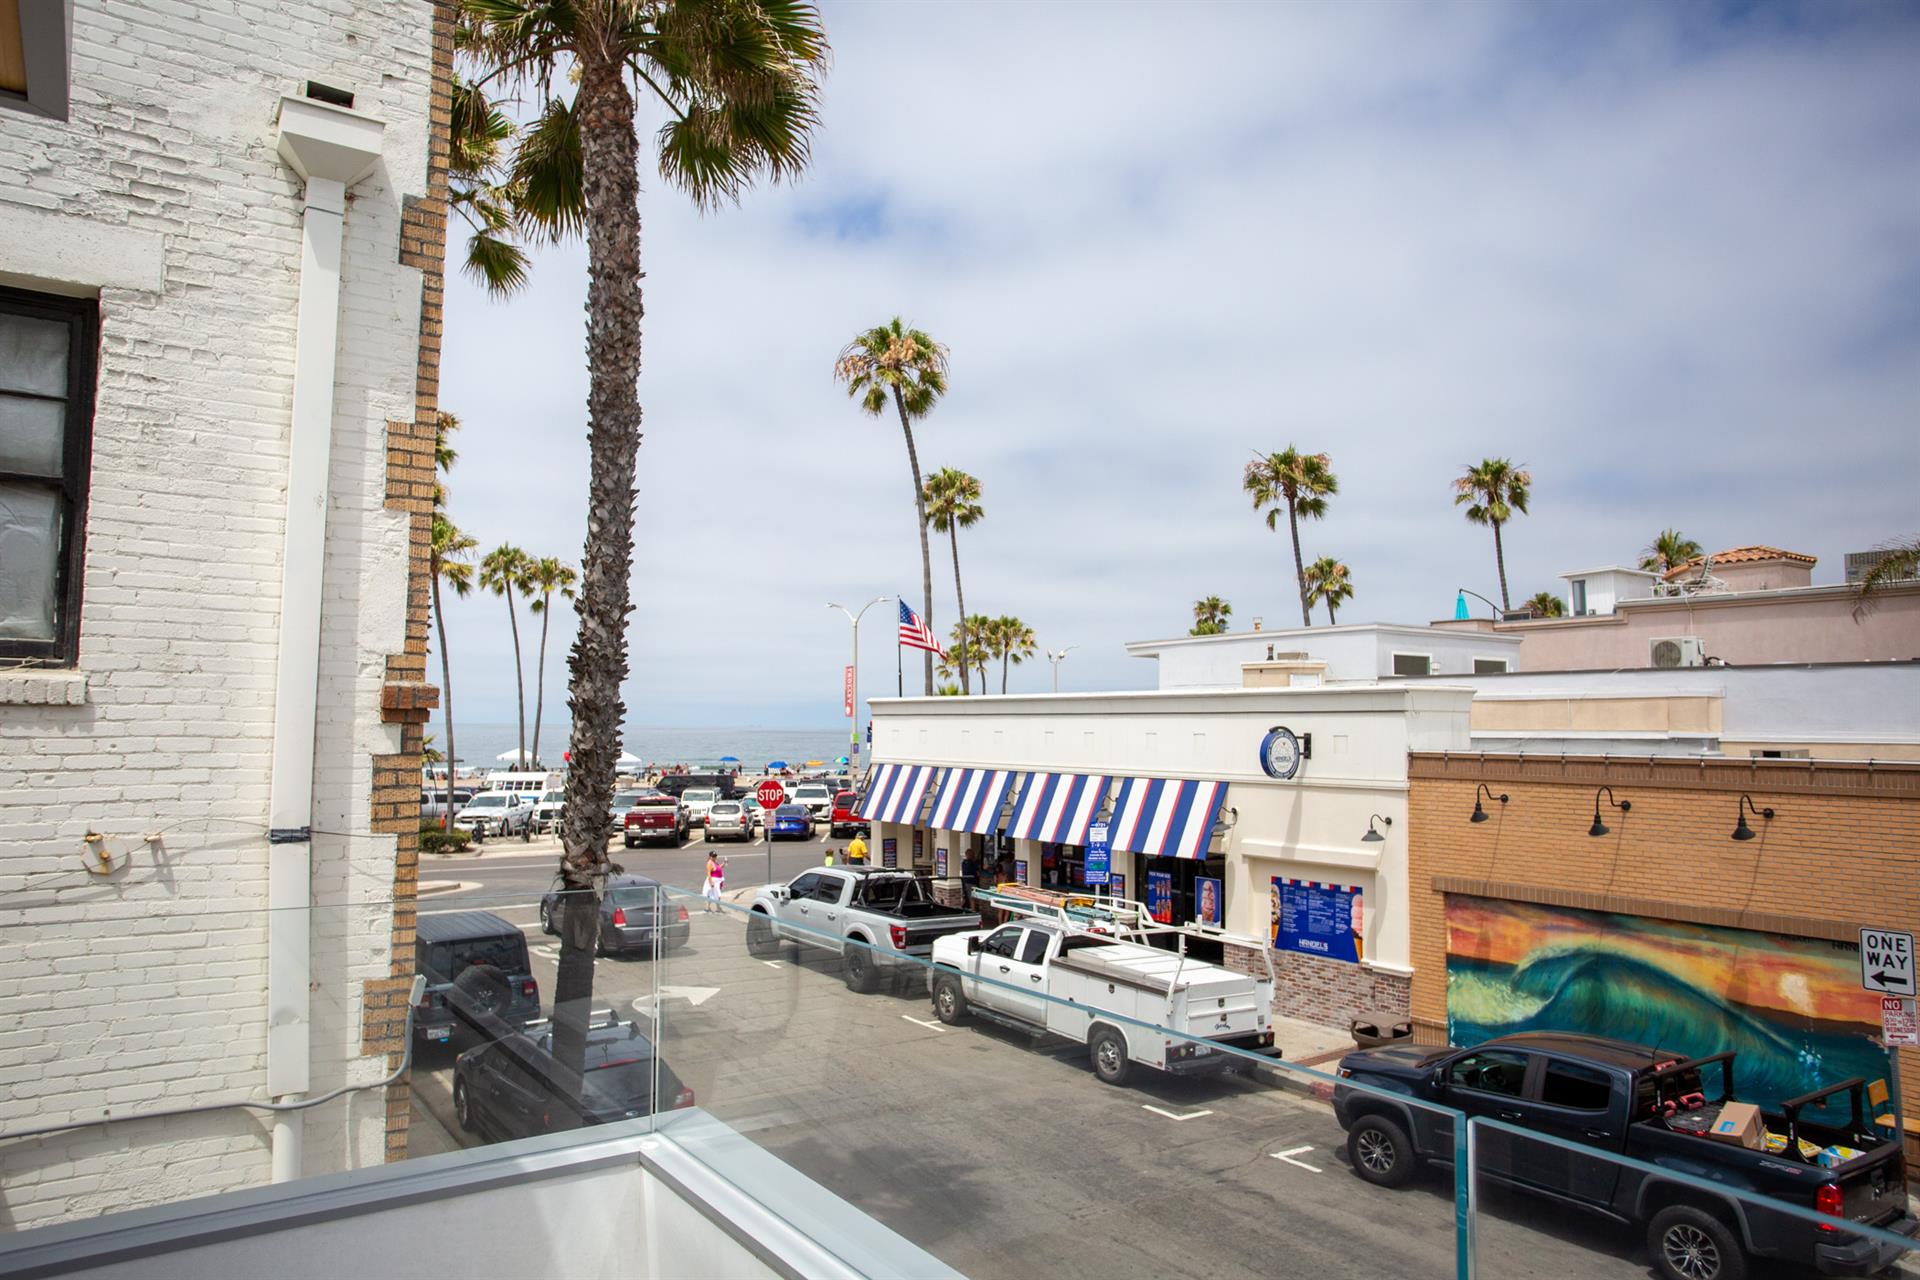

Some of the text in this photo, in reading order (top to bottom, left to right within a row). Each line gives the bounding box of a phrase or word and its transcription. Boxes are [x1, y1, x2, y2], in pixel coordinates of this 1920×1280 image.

[758, 789, 783, 801] STOP
[1867, 935, 1906, 952] ONE
[1867, 952, 1908, 970] WAY
[1884, 1000, 1900, 1009] NO
[1885, 1010, 1915, 1018] PARKING
